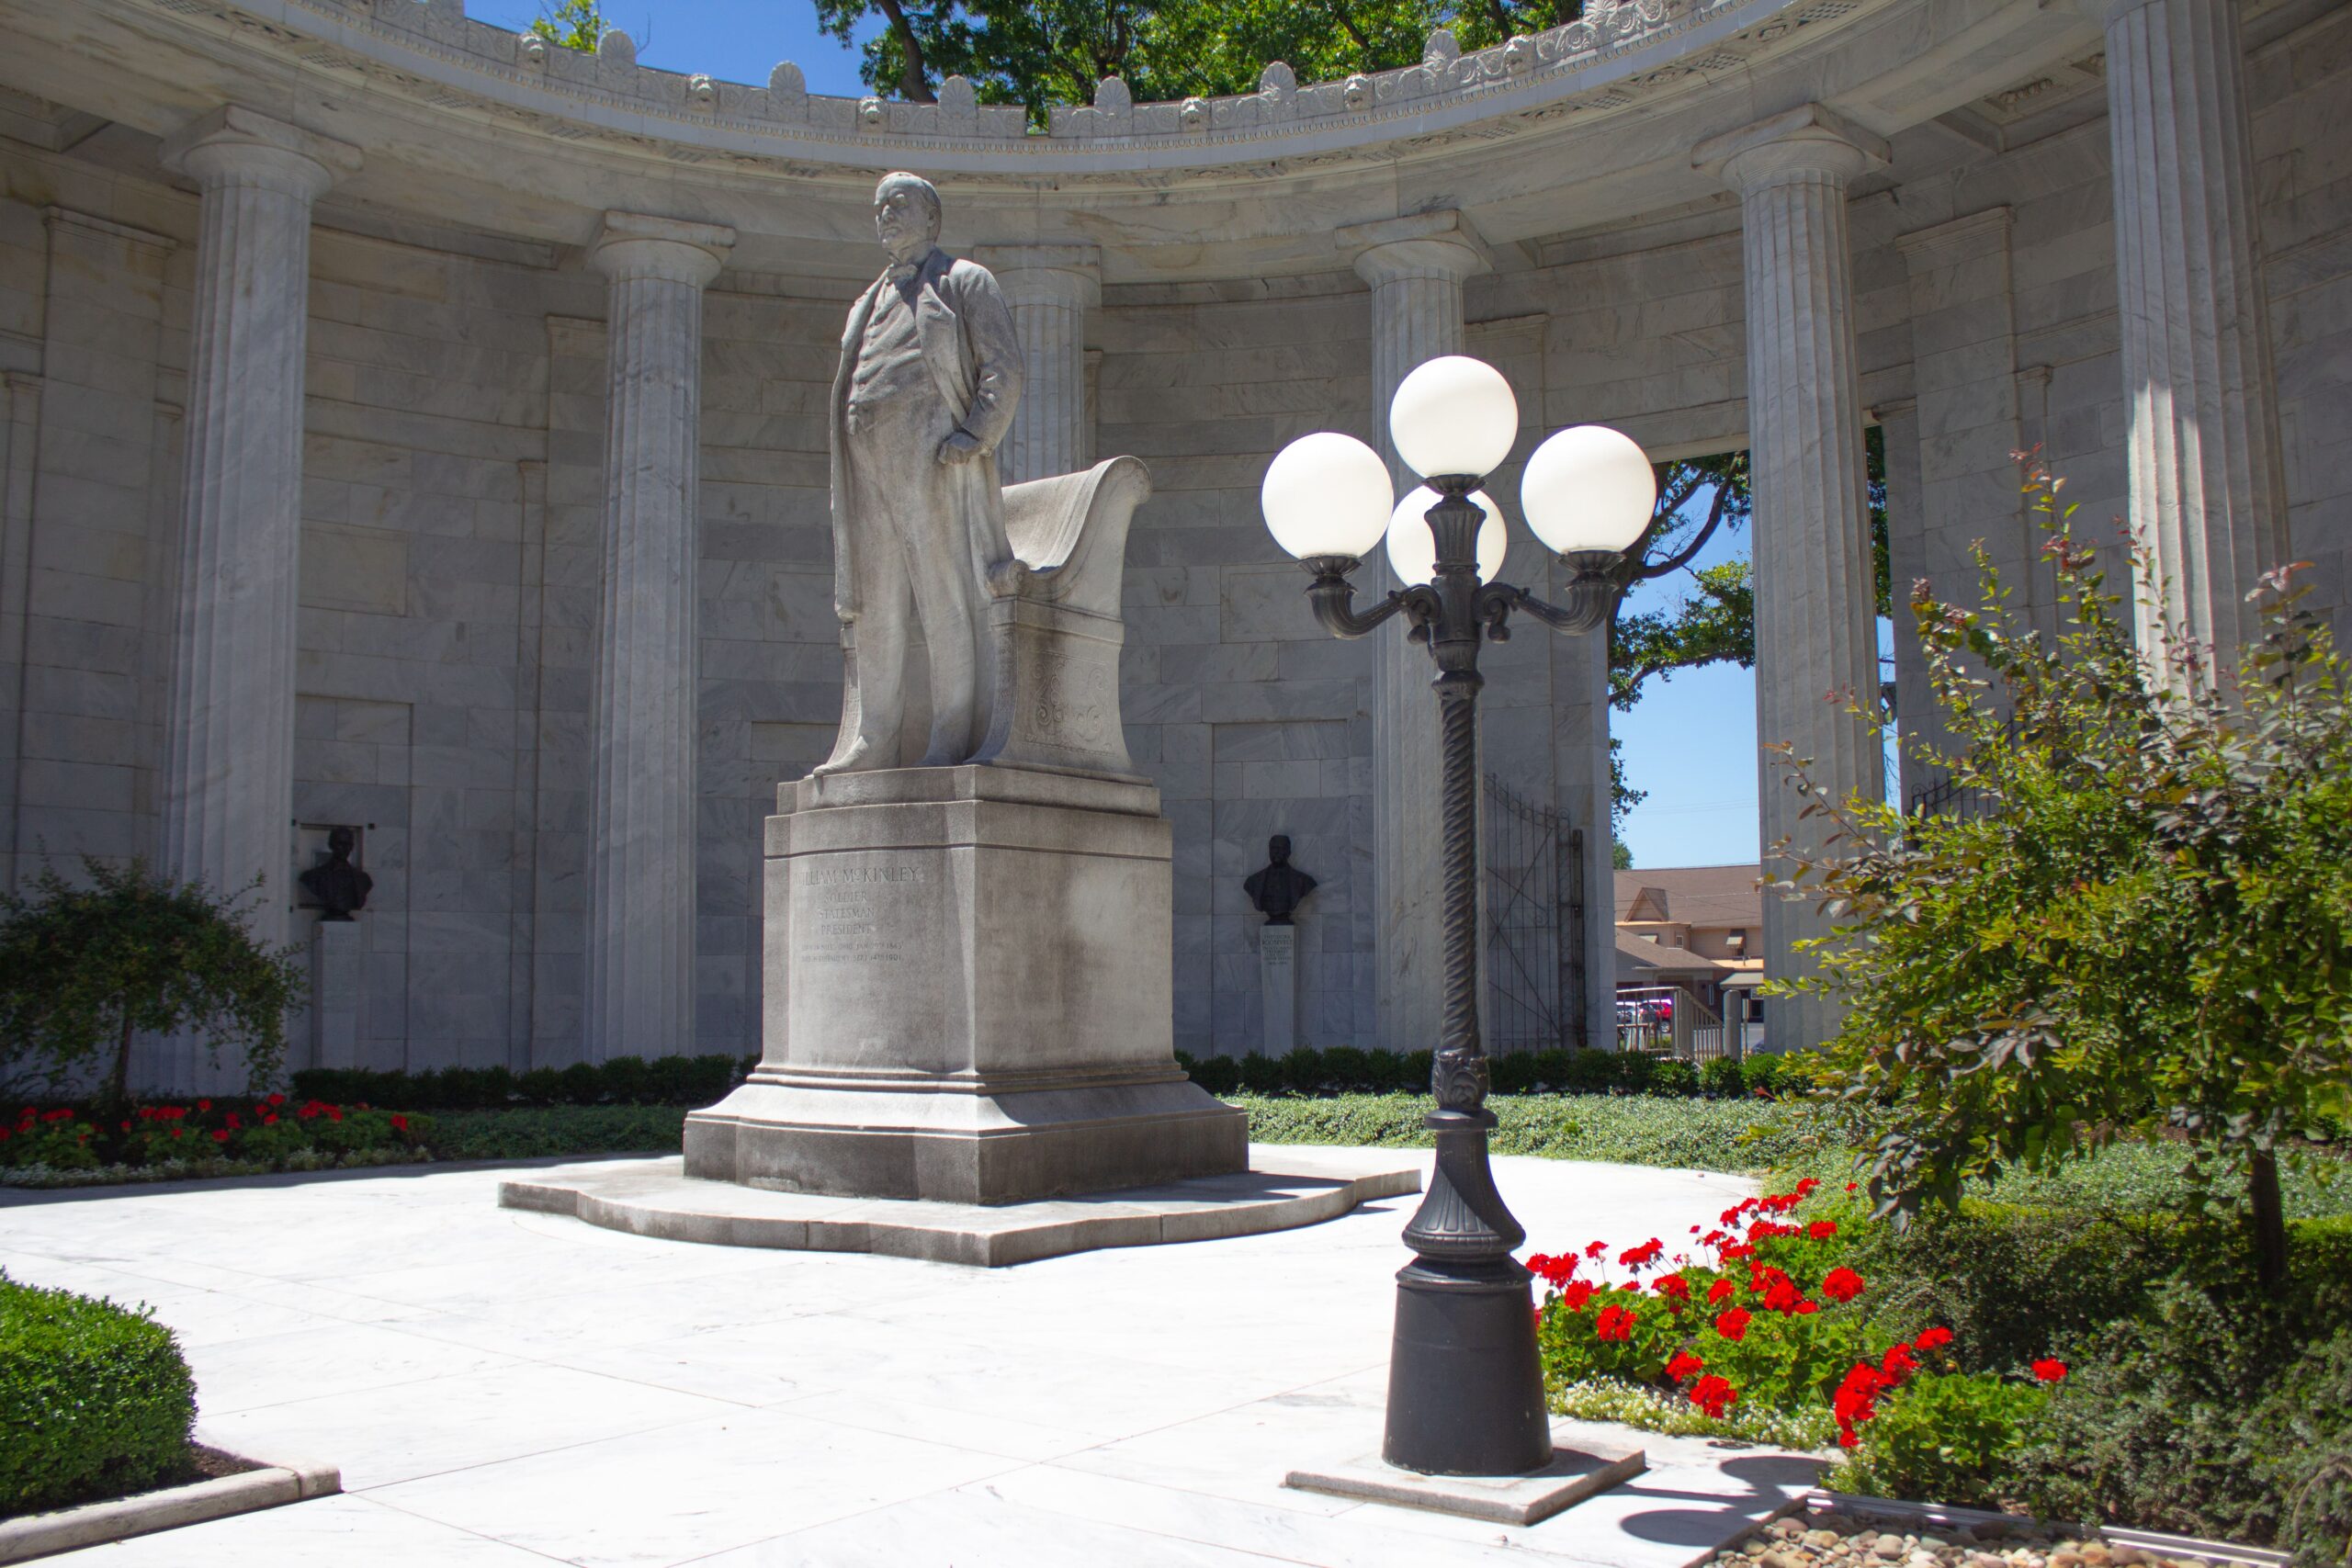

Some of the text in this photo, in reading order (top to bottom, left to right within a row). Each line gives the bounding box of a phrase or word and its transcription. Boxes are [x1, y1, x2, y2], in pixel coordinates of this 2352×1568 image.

[795, 869, 836, 886] WILLIAM
[825, 891, 867, 903] SOLDIER
[819, 908, 875, 919] STATESMAN
[821, 923, 871, 935] PRESIDENT
